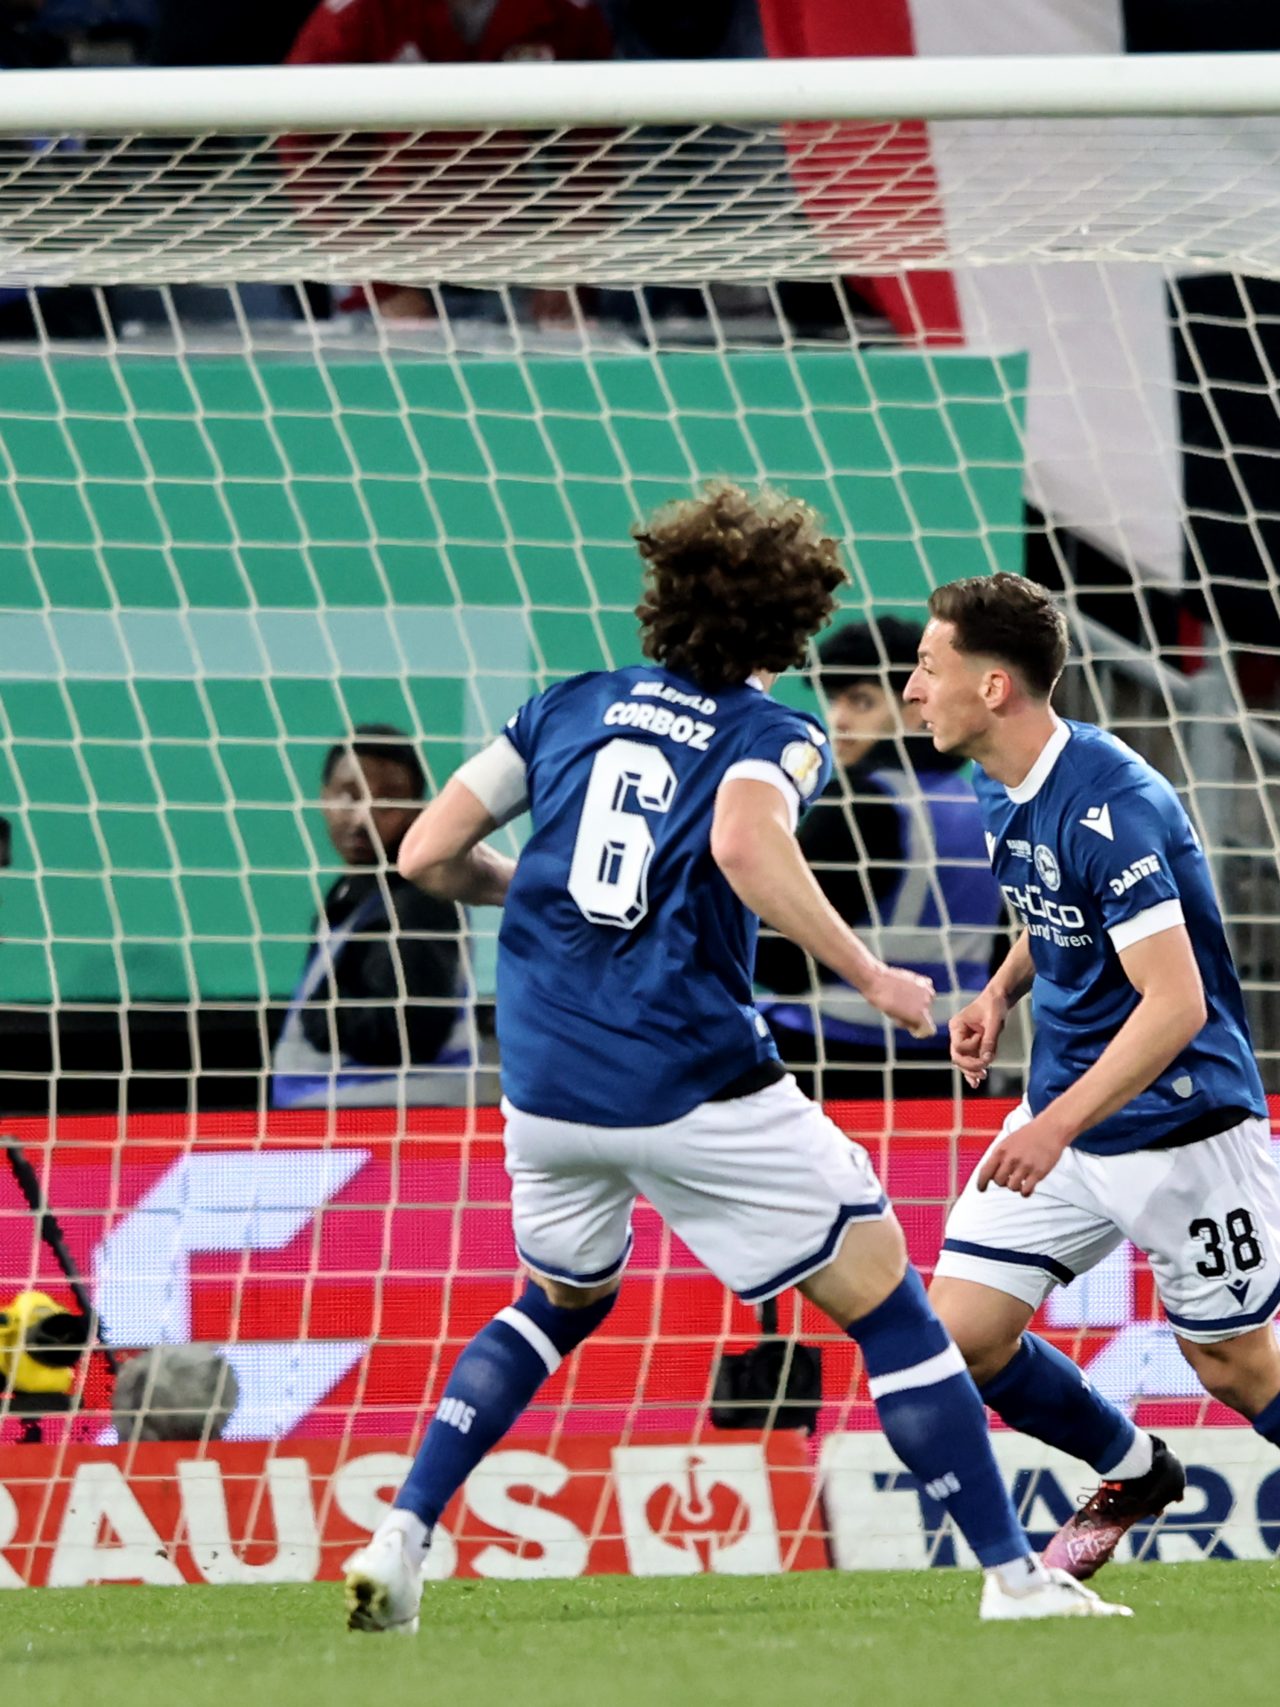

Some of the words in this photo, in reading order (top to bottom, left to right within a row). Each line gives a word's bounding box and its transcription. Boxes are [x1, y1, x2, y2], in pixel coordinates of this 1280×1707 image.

[603, 701, 717, 751] CORBOZ
[567, 738, 678, 930] 6
[1000, 884, 1085, 929] CHÜCO
[1189, 1207, 1266, 1280] 38
